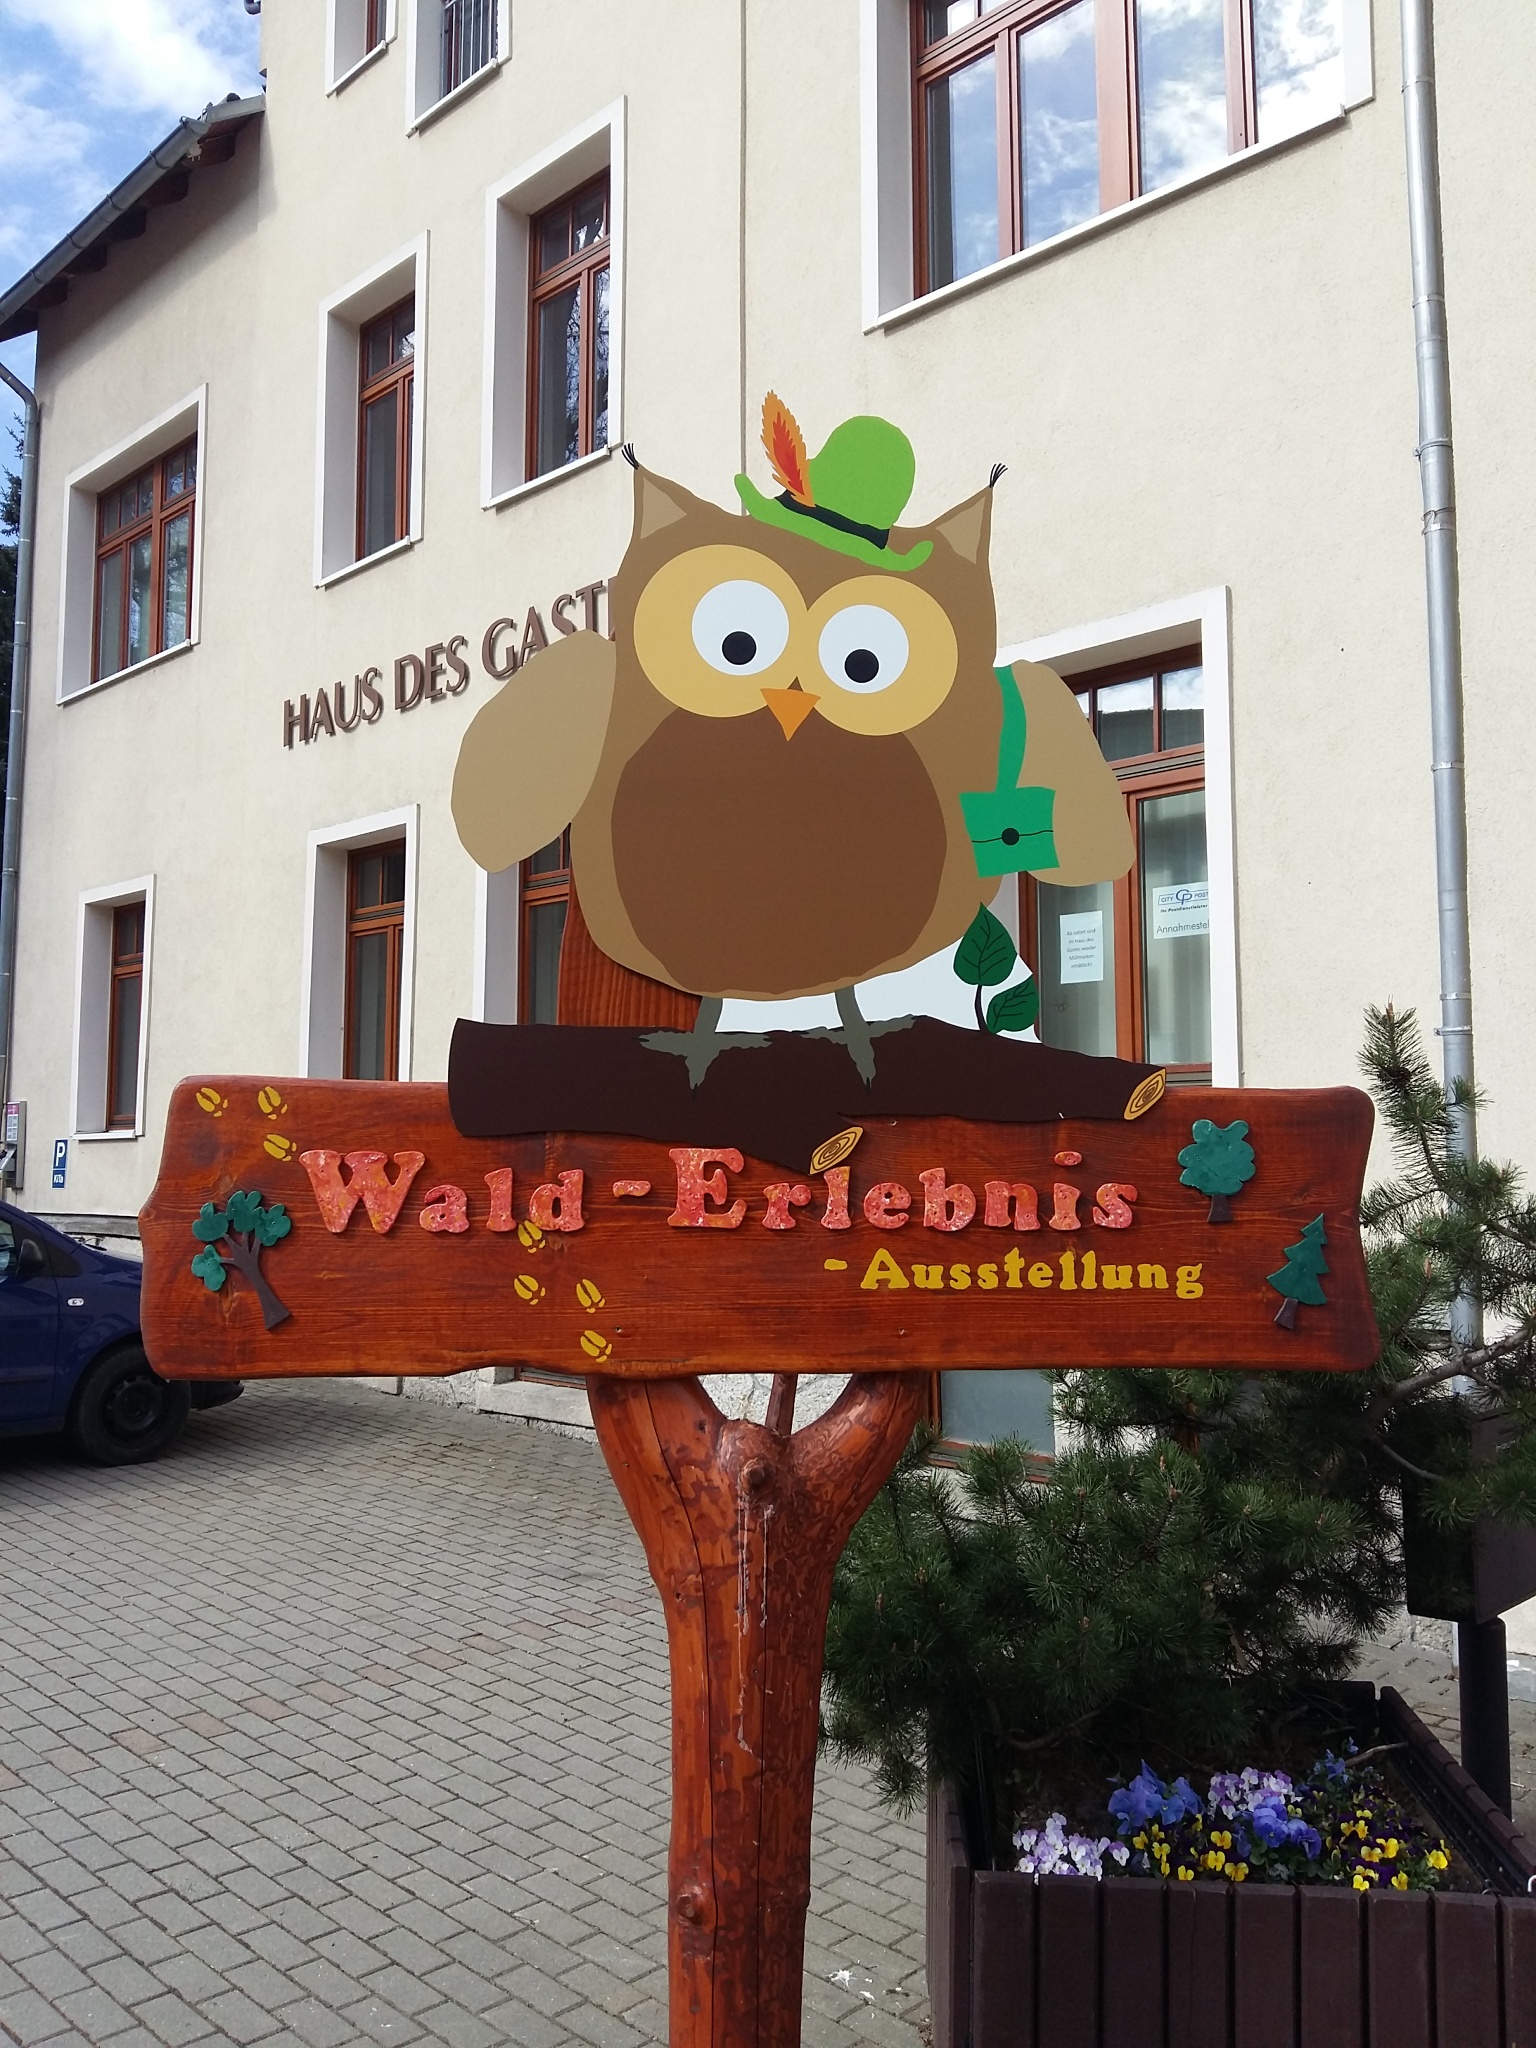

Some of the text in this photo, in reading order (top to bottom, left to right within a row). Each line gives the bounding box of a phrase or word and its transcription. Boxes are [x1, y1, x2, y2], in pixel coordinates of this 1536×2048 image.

[283, 576, 617, 748] HAUS DES GAST
[55, 1141, 66, 1167] P
